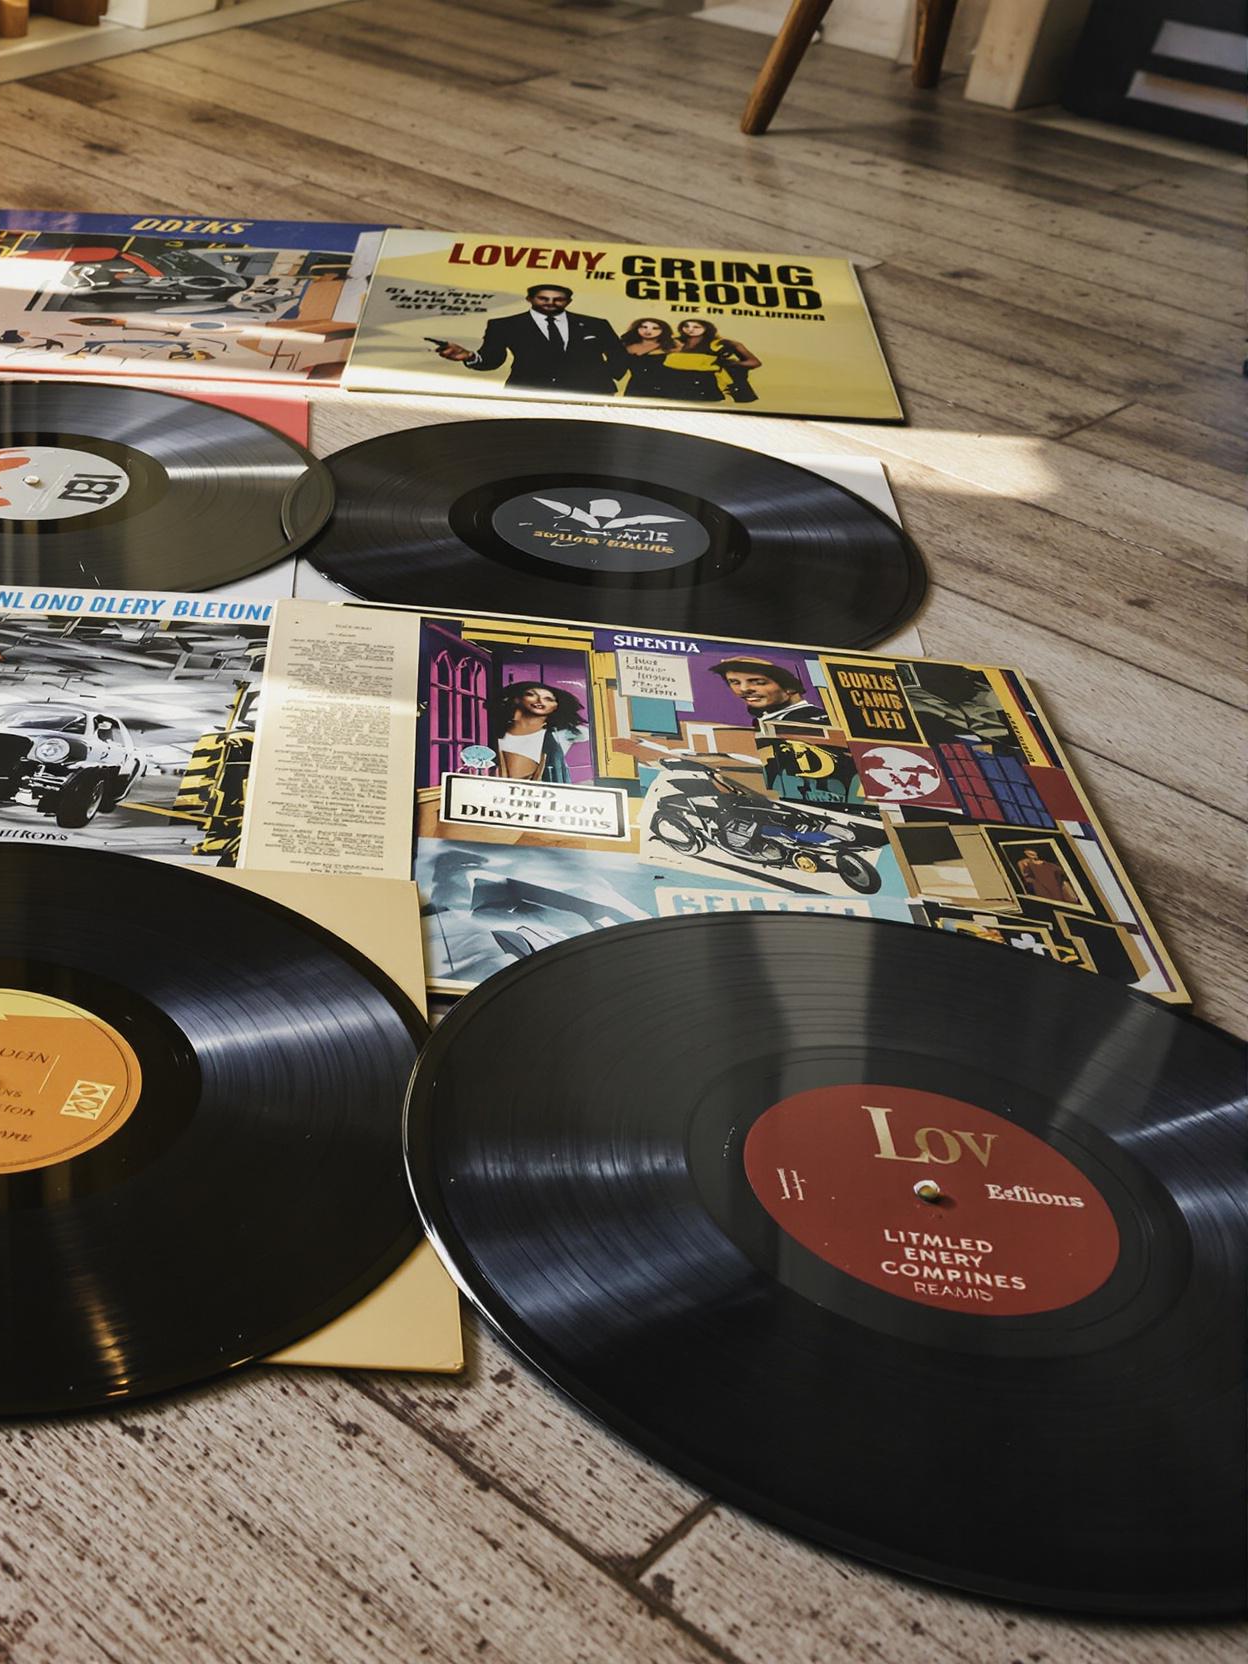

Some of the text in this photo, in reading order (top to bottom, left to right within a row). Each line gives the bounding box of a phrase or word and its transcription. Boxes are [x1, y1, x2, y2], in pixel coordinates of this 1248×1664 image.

[448, 243, 606, 271] LOVENY
[89, 596, 166, 615] DLERY
[613, 634, 701, 653] SIPENTIA
[884, 1229, 993, 1253] LITMLED
[904, 1247, 983, 1268] ENERY
[881, 1260, 1027, 1290] COMPINES
